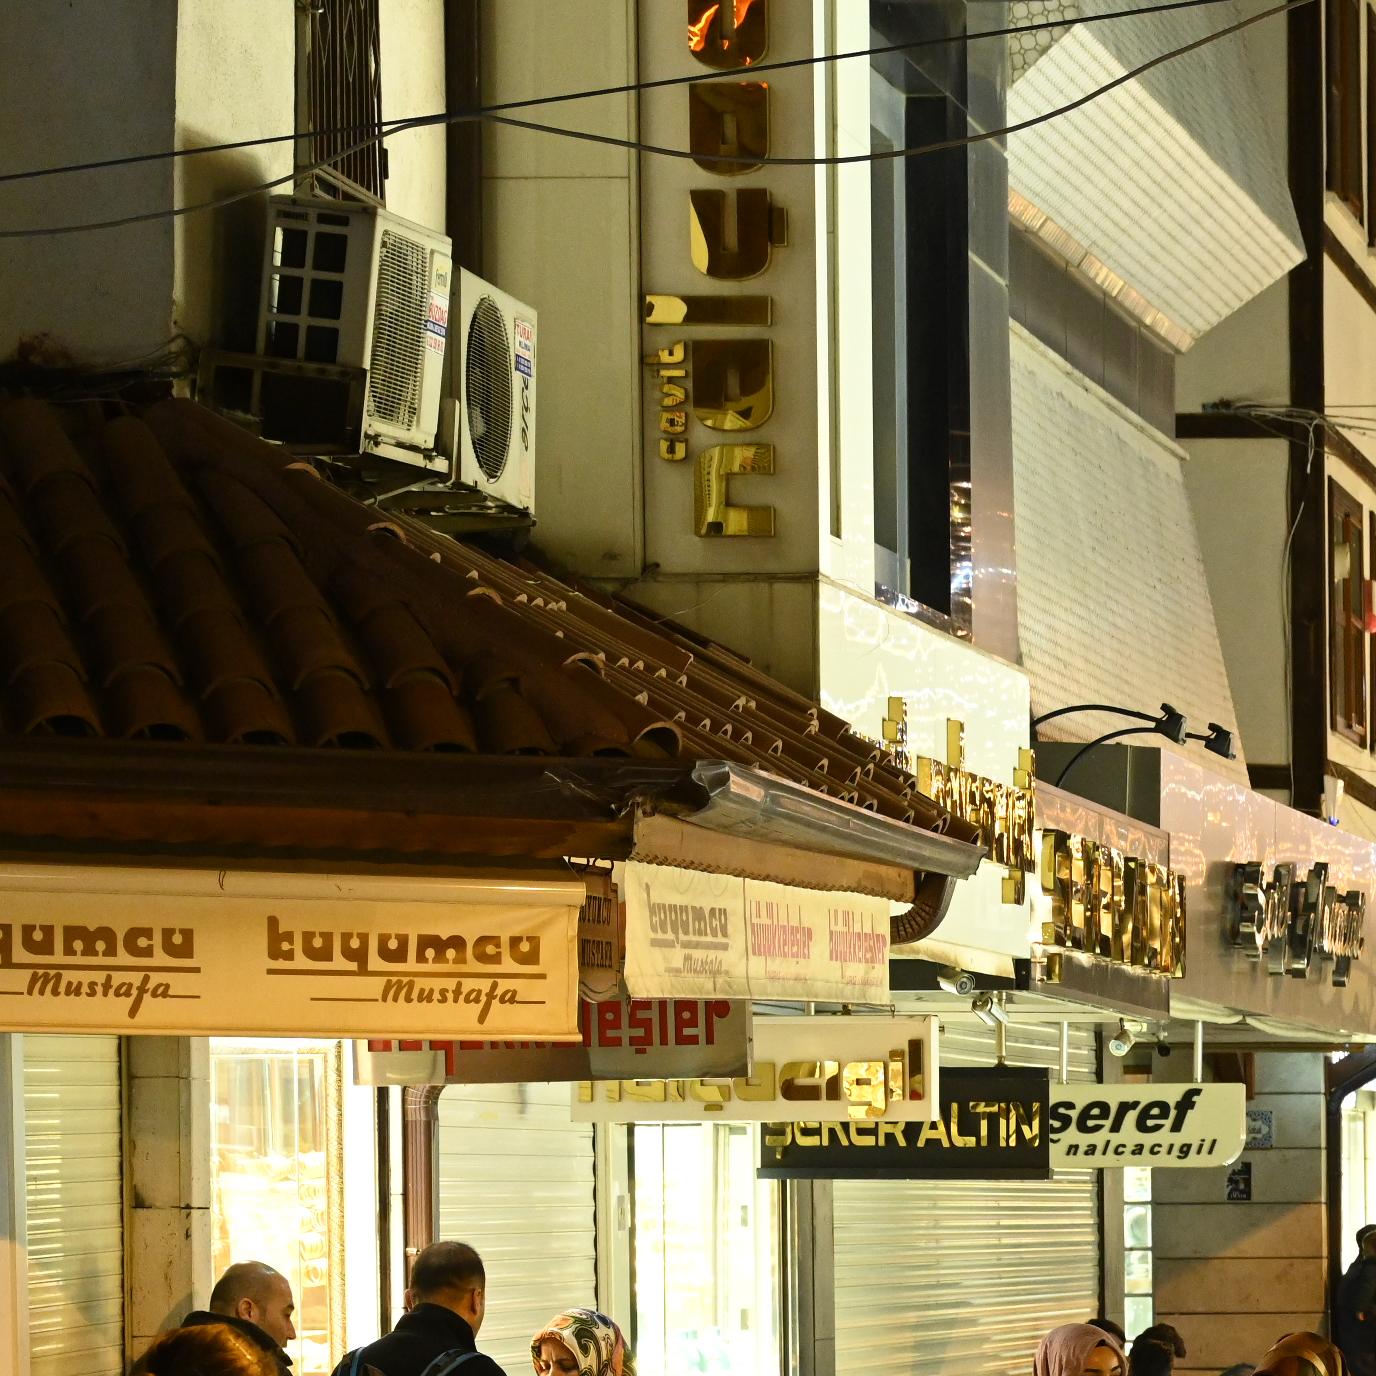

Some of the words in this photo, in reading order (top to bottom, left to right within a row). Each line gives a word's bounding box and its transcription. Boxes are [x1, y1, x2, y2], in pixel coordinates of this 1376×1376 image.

[645, 882, 729, 945] kuyumcu
[266, 915, 542, 973] kuyumcu
[25, 970, 173, 1020] Mustafa
[380, 977, 518, 1025] Mustafa
[916, 1101, 1042, 1148] ALTIN
[1049, 1087, 1203, 1144] şeref
[1066, 1136, 1217, 1160] nalcacıgil
